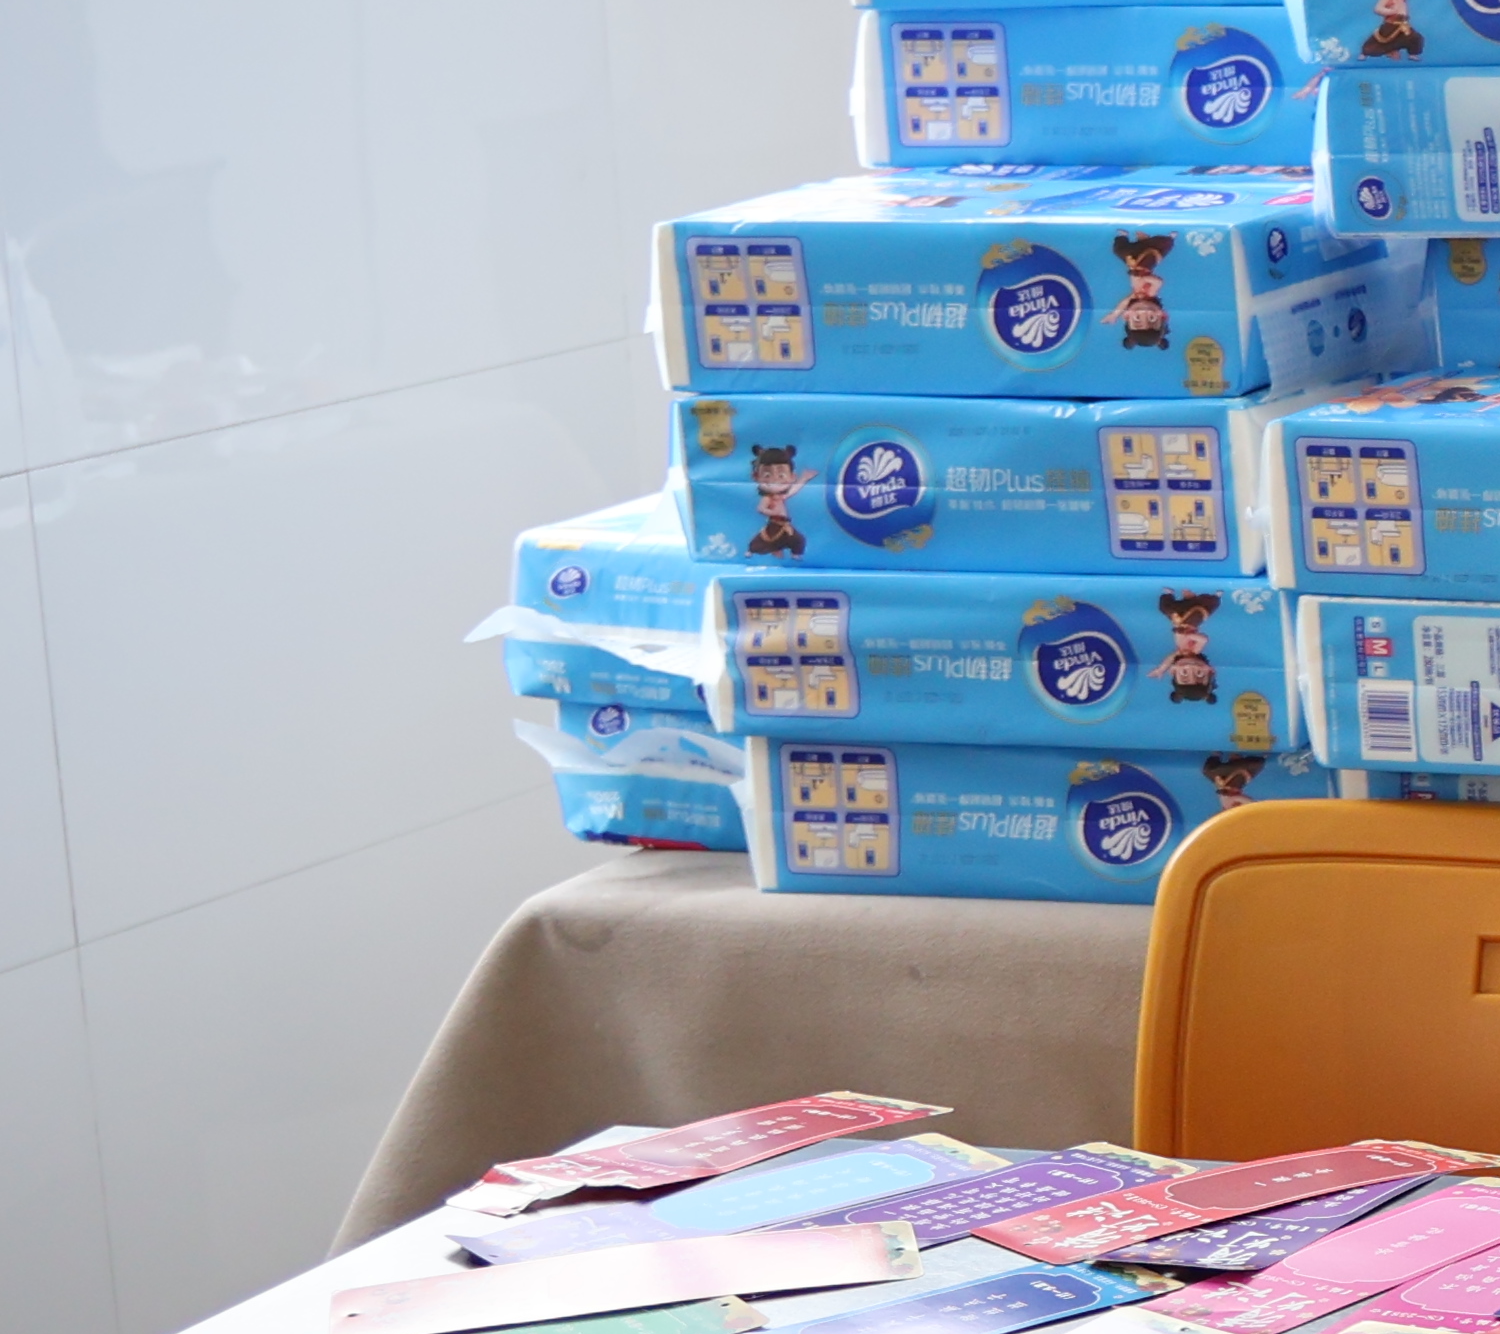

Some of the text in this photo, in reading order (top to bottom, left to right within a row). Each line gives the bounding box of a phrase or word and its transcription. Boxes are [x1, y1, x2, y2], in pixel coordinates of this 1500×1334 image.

[1207, 66, 1236, 81] 维达
[1201, 75, 1252, 97] Vinda
[1016, 284, 1044, 302] 维达
[1008, 293, 1060, 319] Vinda
[858, 474, 907, 500] Vinda
[869, 492, 898, 510] 维达
[1059, 639, 1087, 659] 维达
[1372, 639, 1388, 655] M
[1053, 648, 1104, 674] Vinda
[1106, 799, 1134, 816] 维达
[1099, 806, 1150, 833] Vinda
